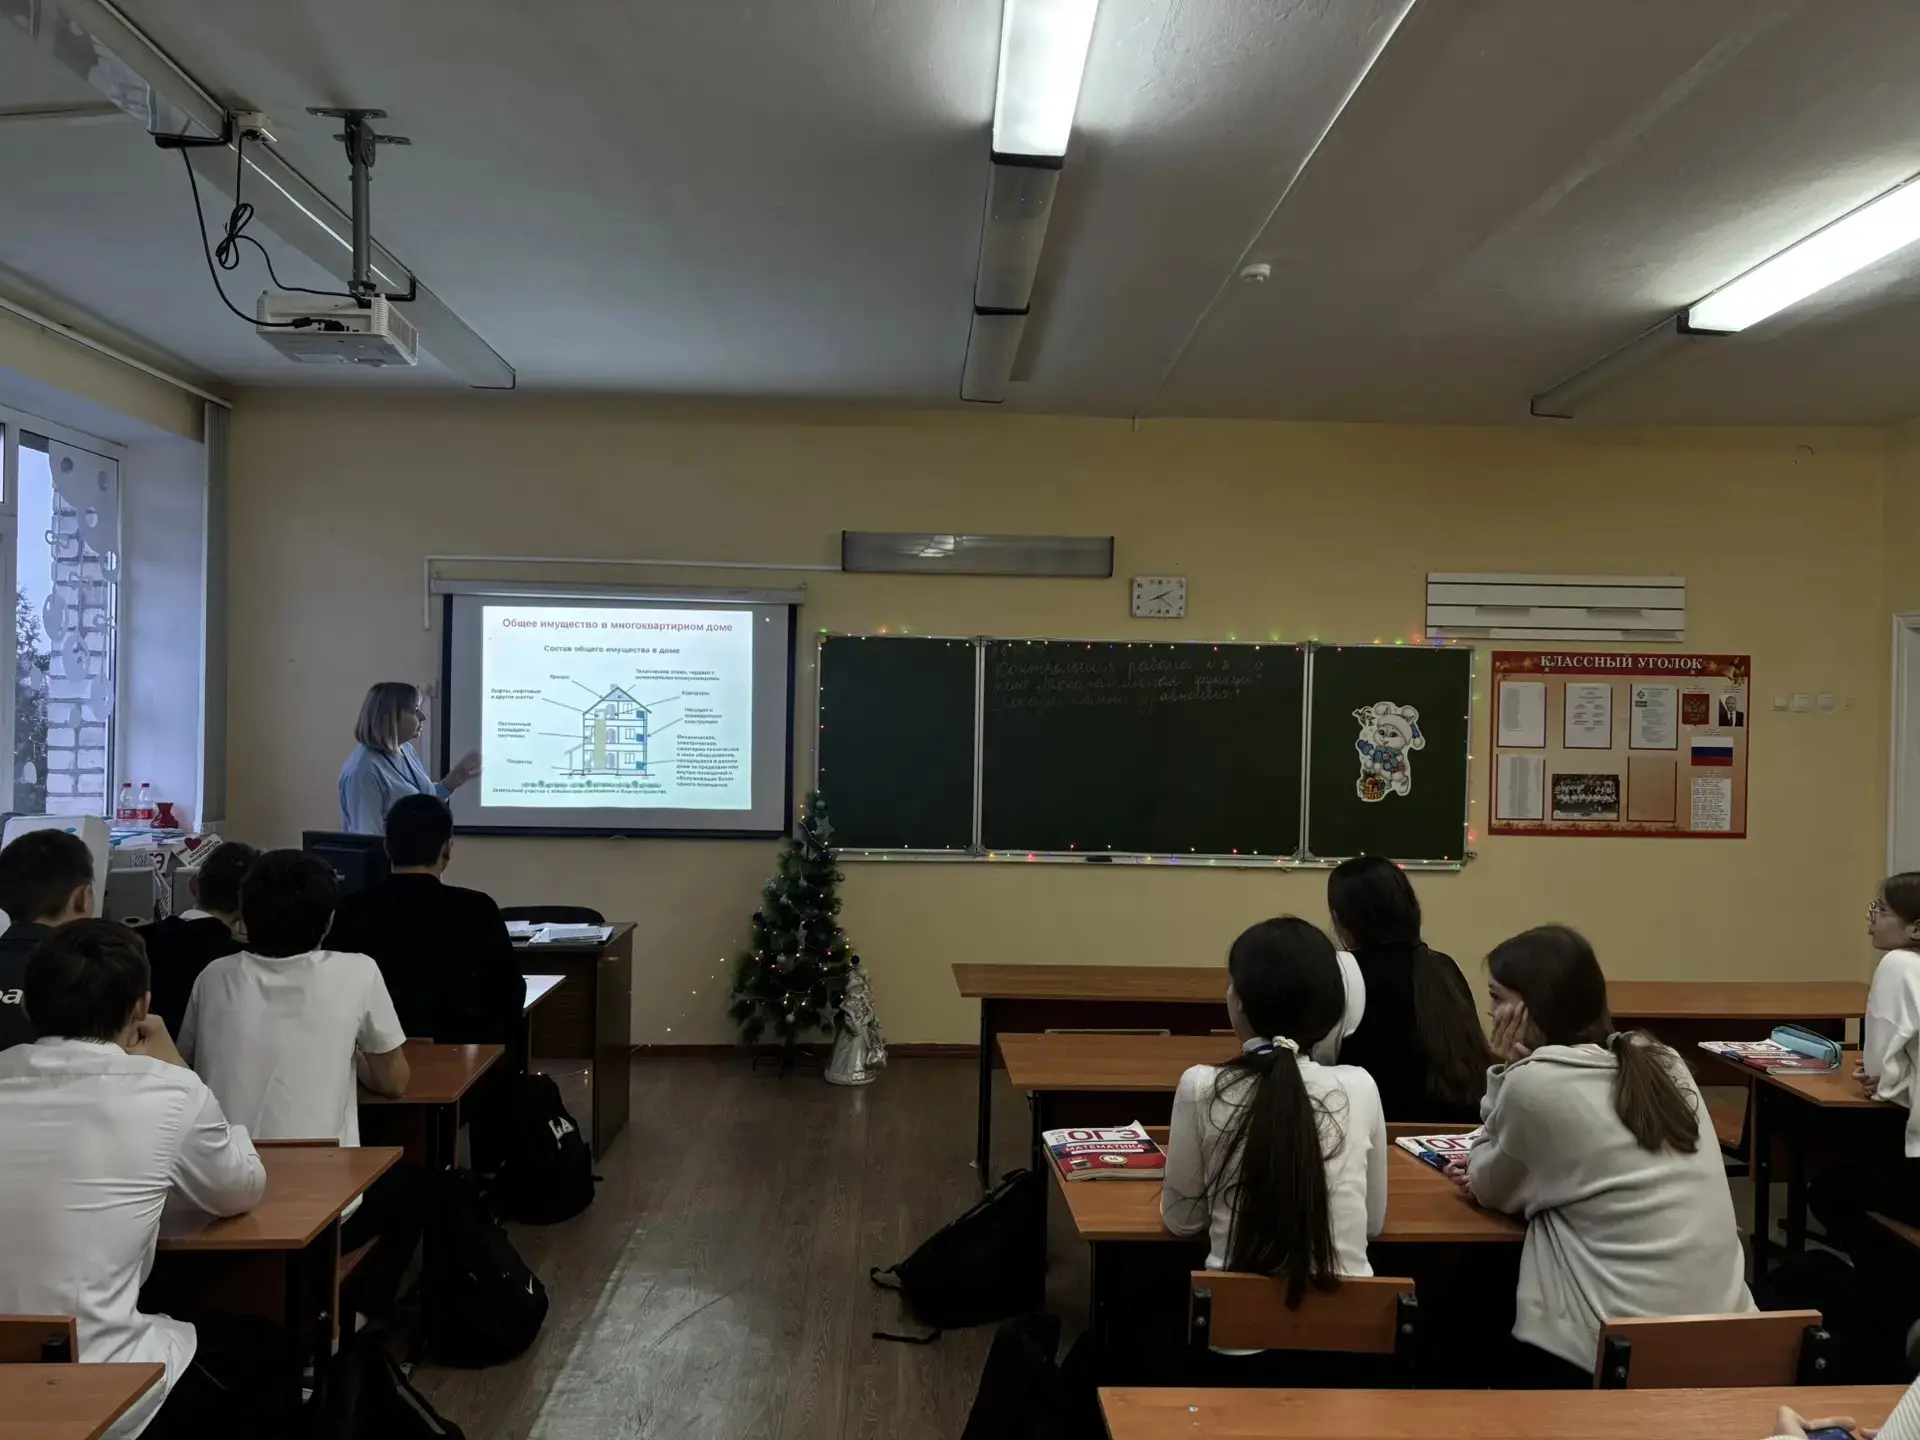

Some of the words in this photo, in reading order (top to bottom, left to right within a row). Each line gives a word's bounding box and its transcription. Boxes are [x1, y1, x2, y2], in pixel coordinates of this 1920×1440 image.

[502, 619, 537, 629] Общее
[540, 620, 598, 630] имущество
[601, 621, 608, 629] в
[610, 622, 704, 632] многоквартирном
[706, 624, 733, 633] доме
[544, 645, 572, 653] Состав
[574, 645, 604, 654] общего
[605, 646, 650, 654] имущества
[1540, 654, 1632, 668] КЛАССНЫЙ
[1637, 657, 1702, 669] УГОЛОК
[1067, 1129, 1141, 1141] ОГЭ
[1065, 1143, 1145, 1152] МАТЕМАТИКА
